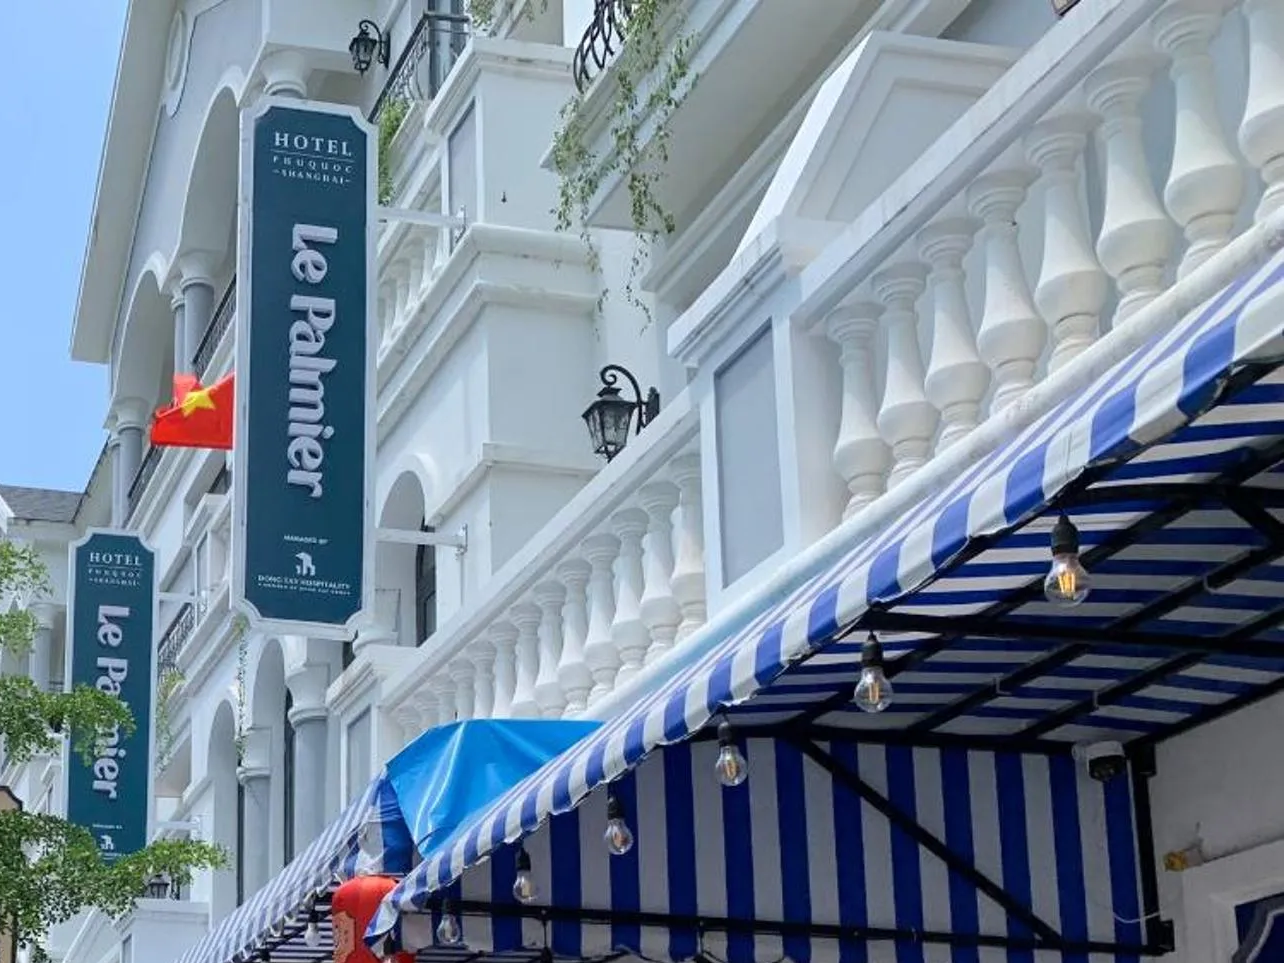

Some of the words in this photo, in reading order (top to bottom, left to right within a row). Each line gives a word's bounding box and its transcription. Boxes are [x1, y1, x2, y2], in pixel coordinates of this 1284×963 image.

[274, 131, 352, 157] HOTEL
[290, 222, 338, 284] Le
[286, 293, 337, 499] Palmier
[89, 552, 143, 566] HOTEL
[97, 605, 131, 648] Le
